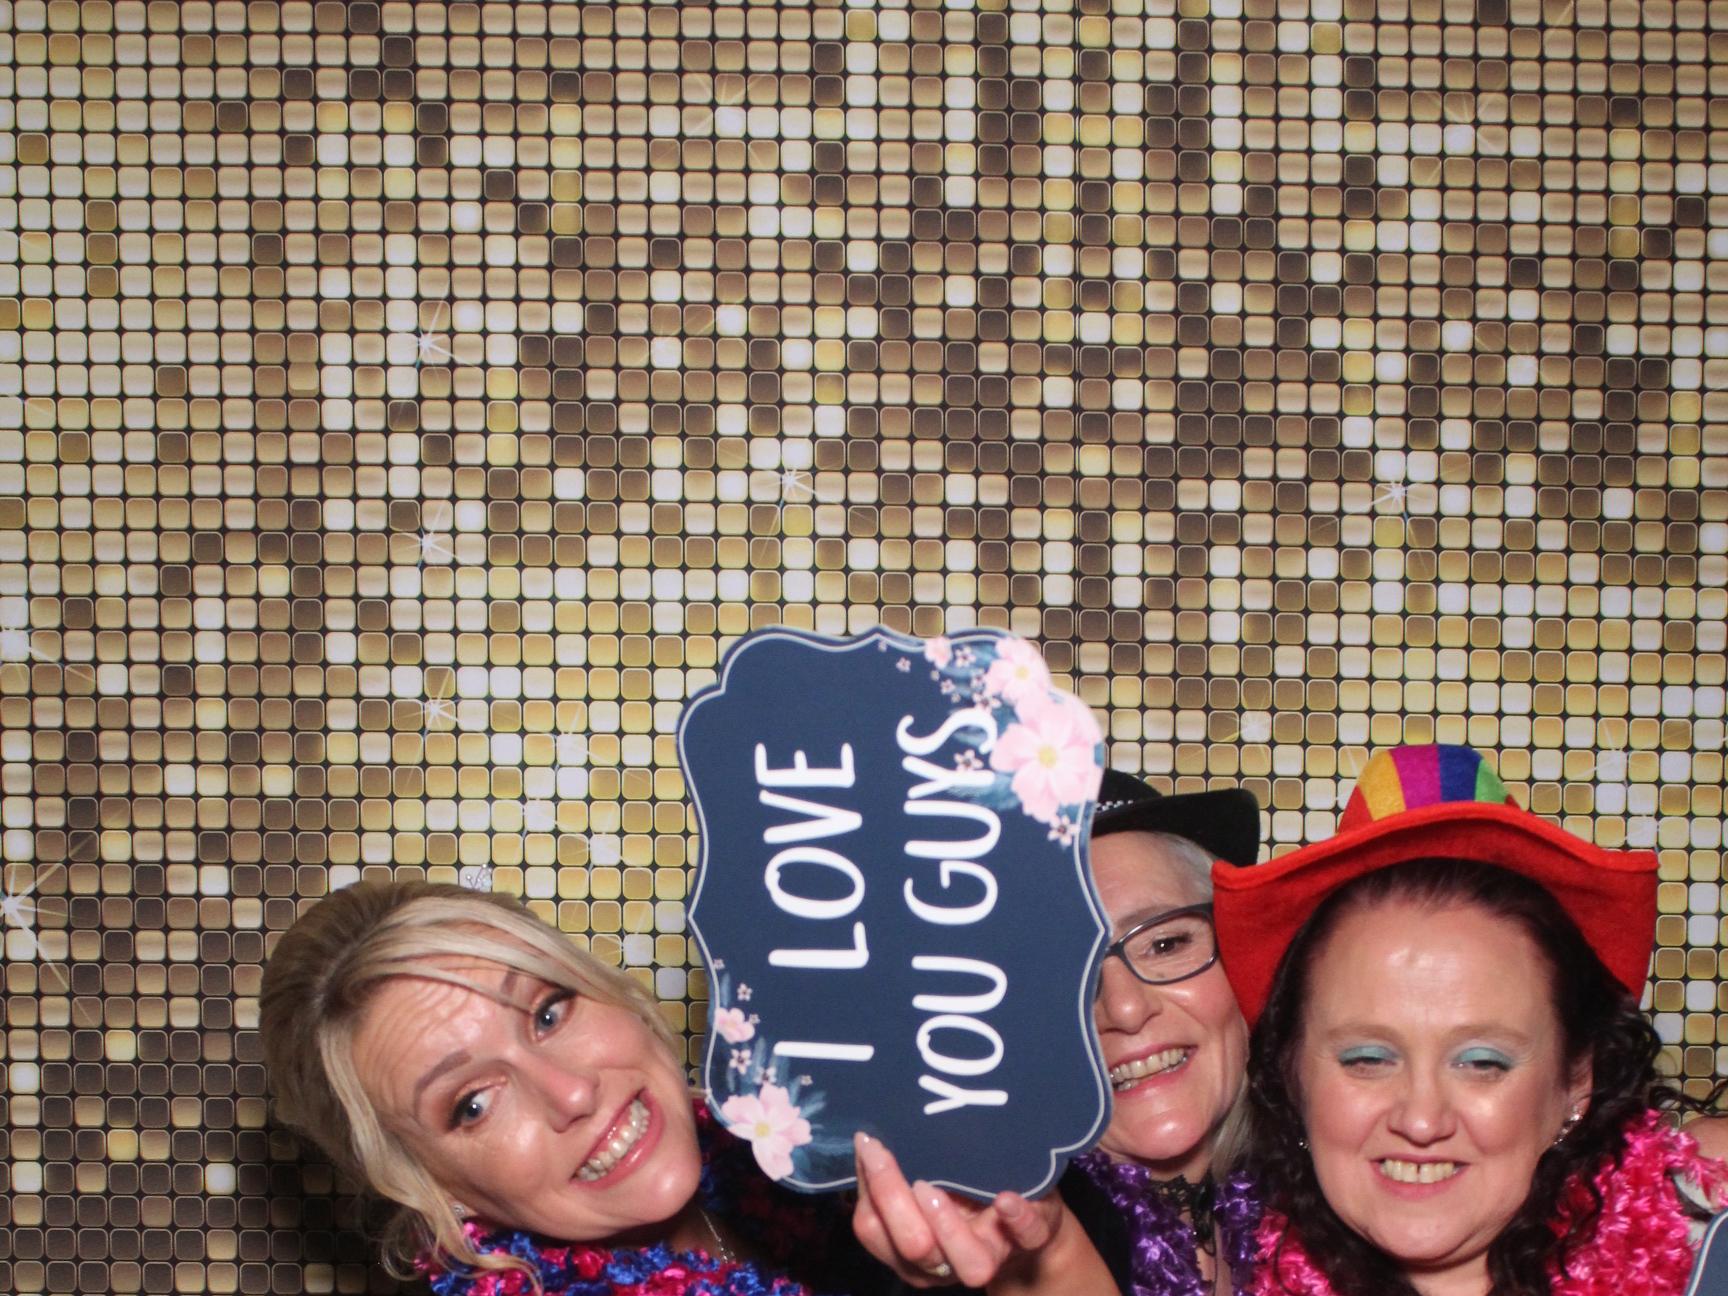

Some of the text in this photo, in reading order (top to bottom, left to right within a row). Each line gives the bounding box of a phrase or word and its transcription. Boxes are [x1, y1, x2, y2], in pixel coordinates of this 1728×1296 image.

[754, 742, 875, 1062] I LOVE
[896, 707, 1009, 1116] YOU GUYS
